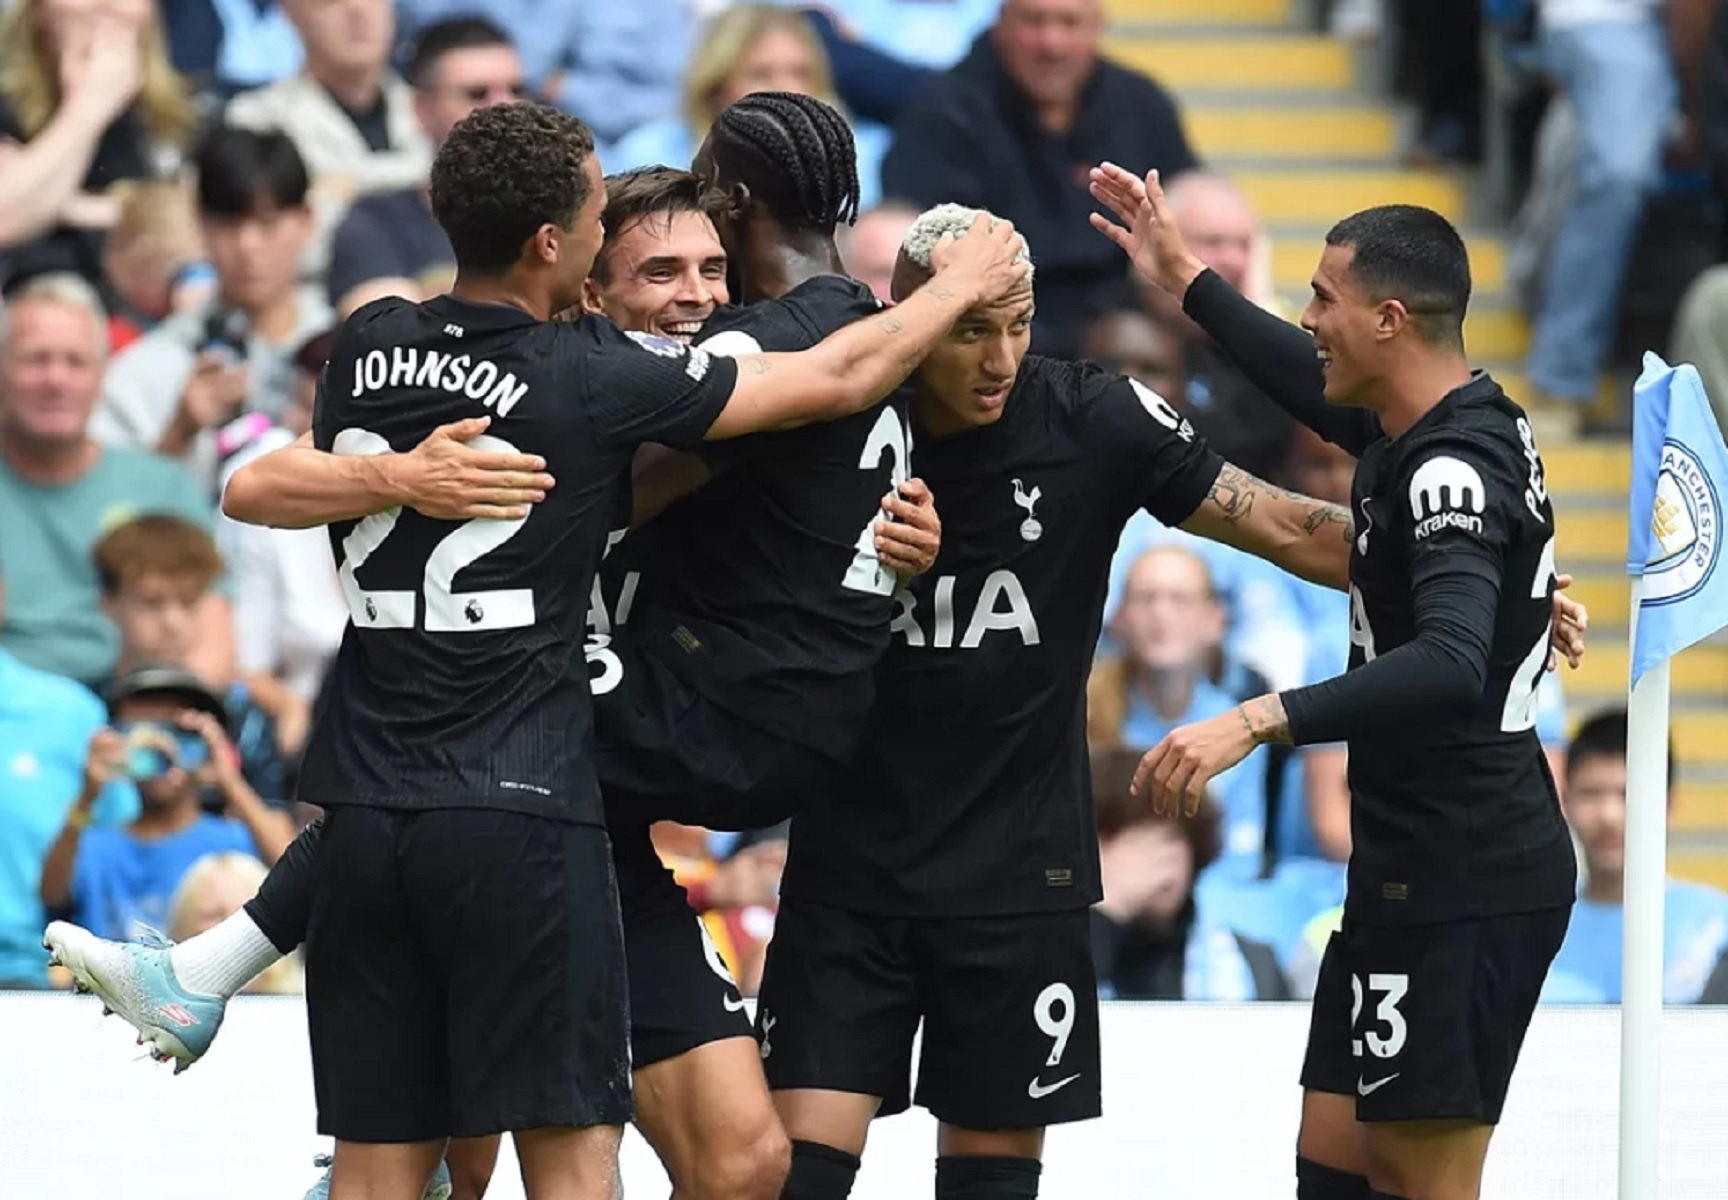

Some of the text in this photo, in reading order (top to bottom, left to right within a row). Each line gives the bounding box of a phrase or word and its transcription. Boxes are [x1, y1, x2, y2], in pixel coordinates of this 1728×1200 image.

[352, 346, 529, 418] JOHNSON
[332, 427, 536, 632] 22
[841, 405, 914, 596] 2
[1663, 452, 1712, 568] ANCHESTER
[1033, 982, 1076, 1067] 9
